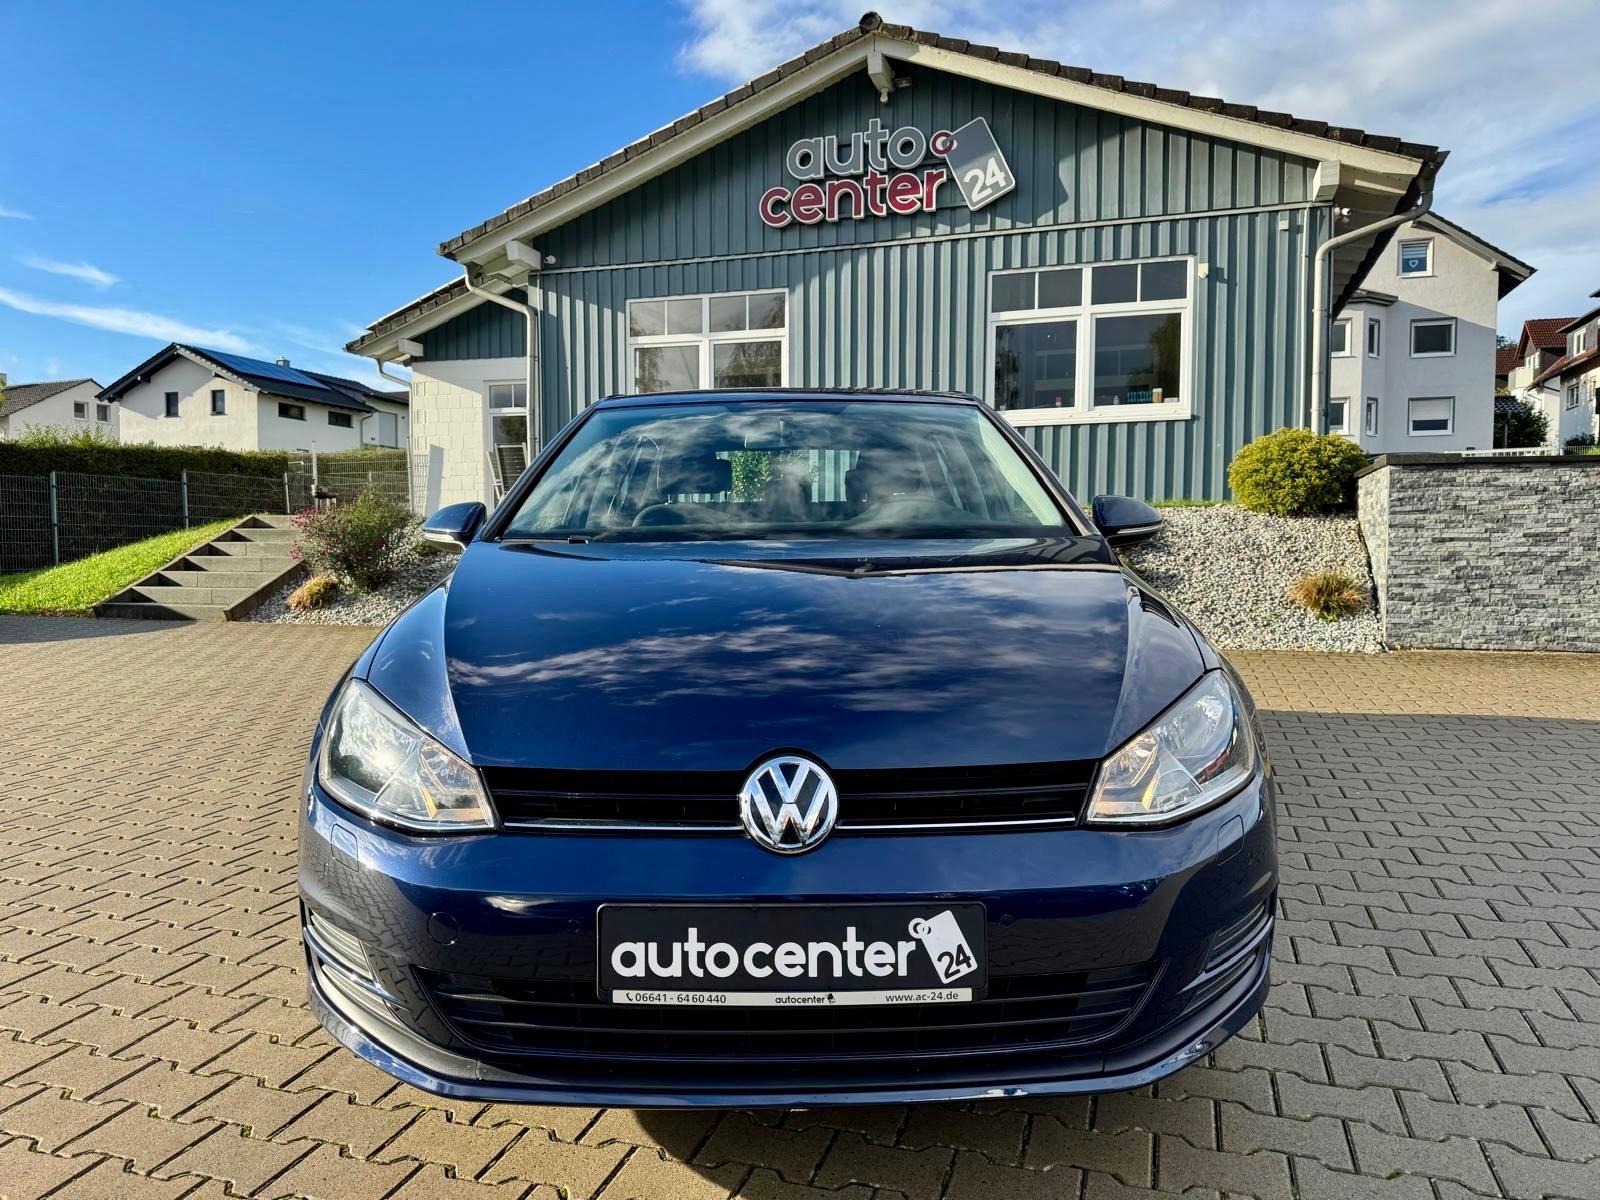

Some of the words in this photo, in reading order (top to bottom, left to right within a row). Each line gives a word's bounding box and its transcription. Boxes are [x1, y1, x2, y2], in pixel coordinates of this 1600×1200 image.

[787, 118, 927, 181] auto
[759, 167, 947, 228] center
[963, 157, 1006, 204] 24
[745, 758, 834, 849] VW
[937, 942, 972, 980] 24
[635, 992, 667, 1002] 06641
[775, 995, 825, 1004] autocenter
[885, 991, 959, 1002] www.ac-24.de
